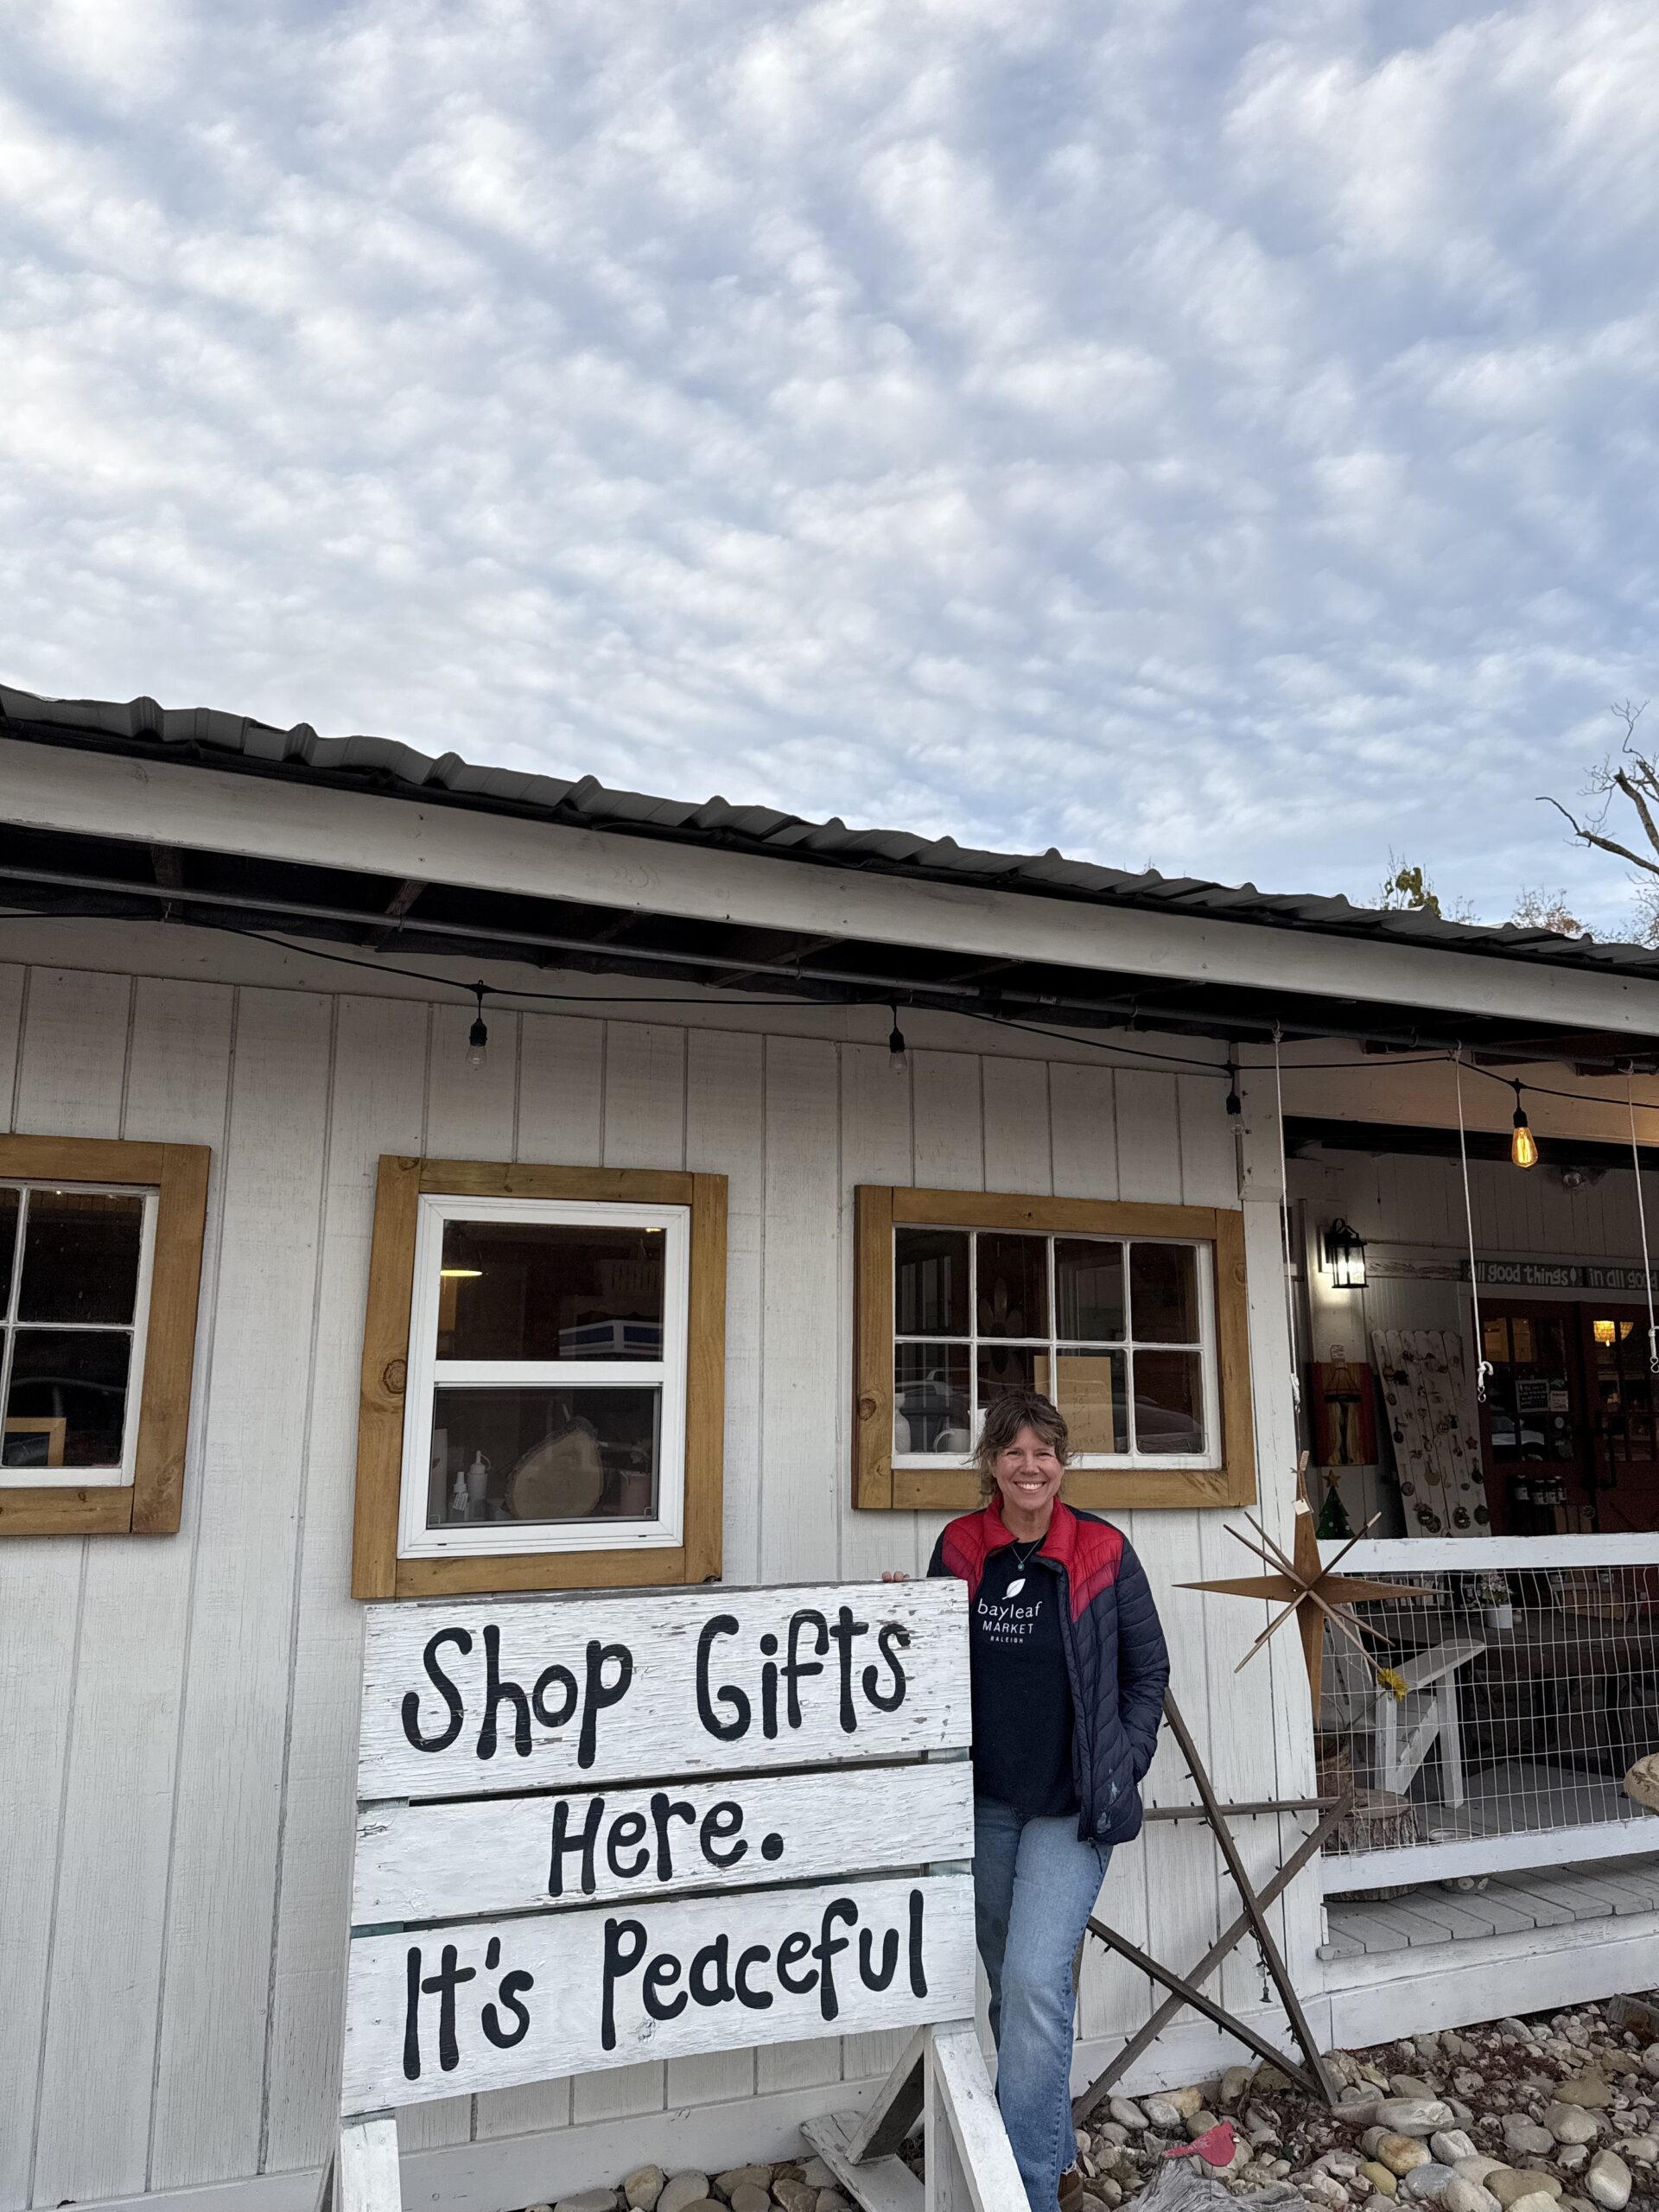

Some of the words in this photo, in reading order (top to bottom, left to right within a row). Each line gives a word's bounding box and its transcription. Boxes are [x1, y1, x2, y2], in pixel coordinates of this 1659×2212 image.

[1467, 1262, 1485, 1281] all
[1487, 1263, 1521, 1282] good
[1523, 1265, 1568, 1286] things
[1589, 1268, 1604, 1287] in
[1606, 1269, 1624, 1287] all
[977, 1598, 1043, 1622] bayleaf
[982, 1620, 1033, 1634] MARKET
[402, 1625, 632, 1769] Shop
[696, 1606, 911, 1740] Gifts
[548, 1792, 784, 1897] Here.
[404, 1937, 533, 2080] It's
[601, 1890, 927, 2050] Peaceful
